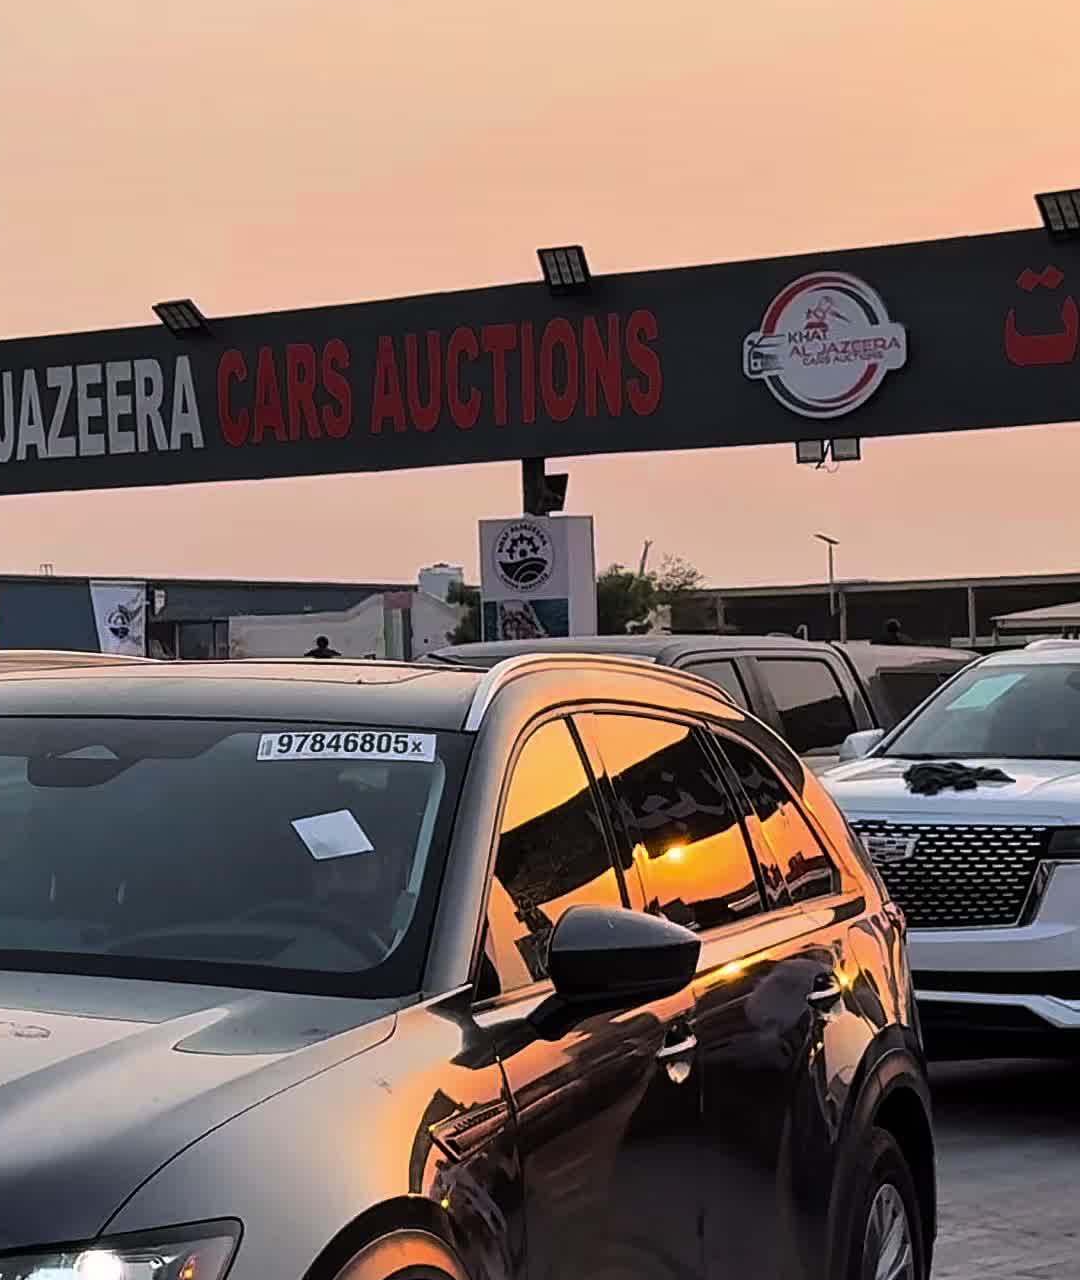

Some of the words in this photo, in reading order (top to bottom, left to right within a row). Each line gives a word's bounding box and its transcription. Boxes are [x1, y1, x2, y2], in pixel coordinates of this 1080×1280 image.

[788, 327, 828, 344] KHAT
[790, 345, 810, 358] AL
[217, 337, 353, 448] CARS
[370, 309, 663, 434] AUCTIONS
